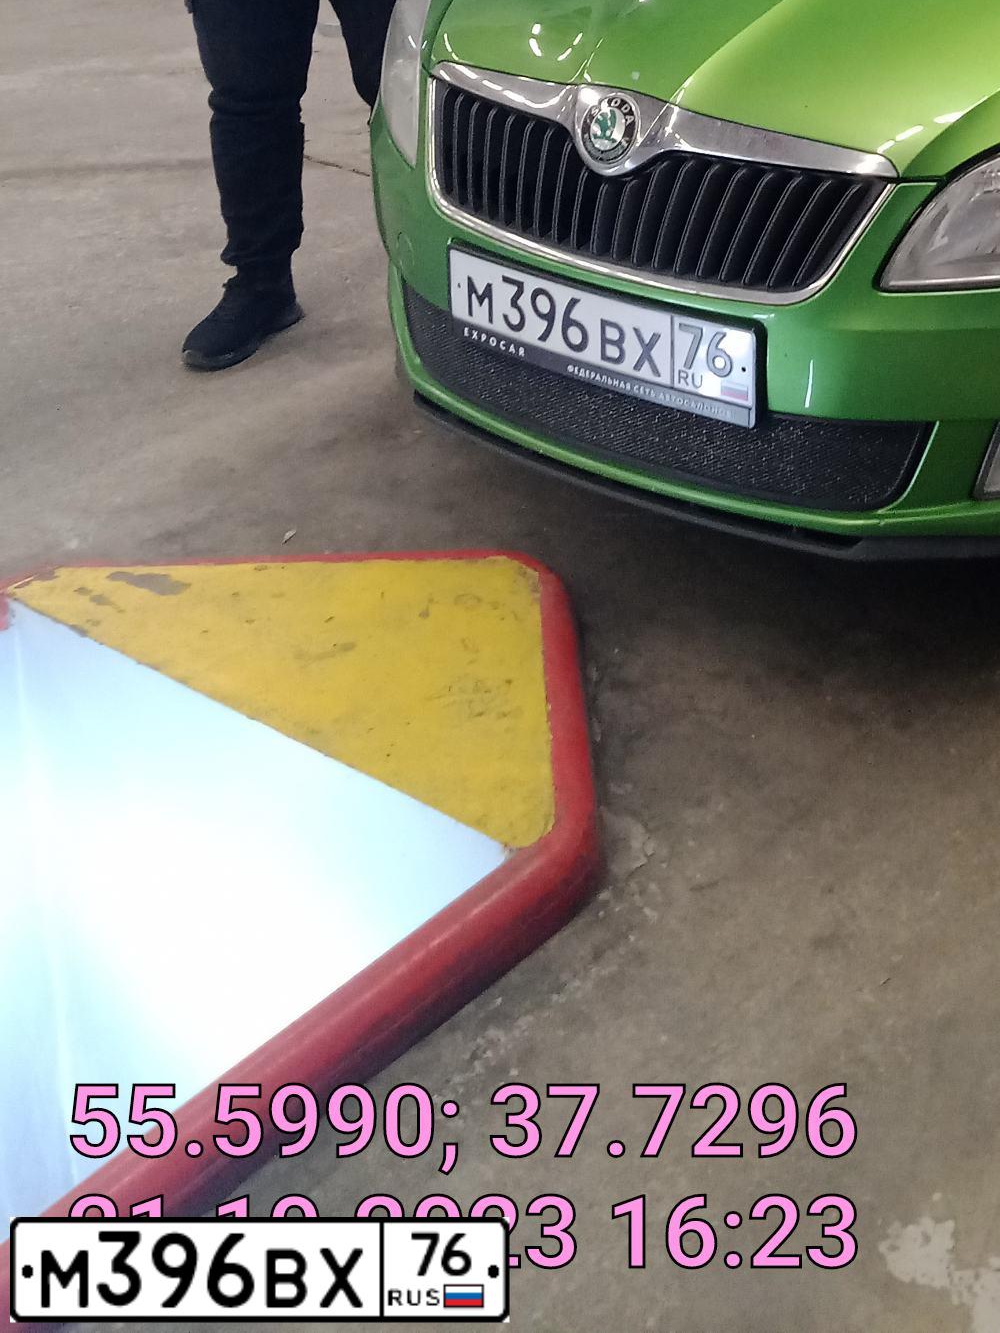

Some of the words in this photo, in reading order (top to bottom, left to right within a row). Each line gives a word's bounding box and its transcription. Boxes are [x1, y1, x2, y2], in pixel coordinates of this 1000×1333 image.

[463, 327, 526, 357] EXPOCAR
[678, 322, 733, 378] 76
[567, 364, 632, 392] ФЕДЕРАЛЬНАЯ
[633, 384, 656, 399] СЕТЬ
[677, 369, 703, 389] RU
